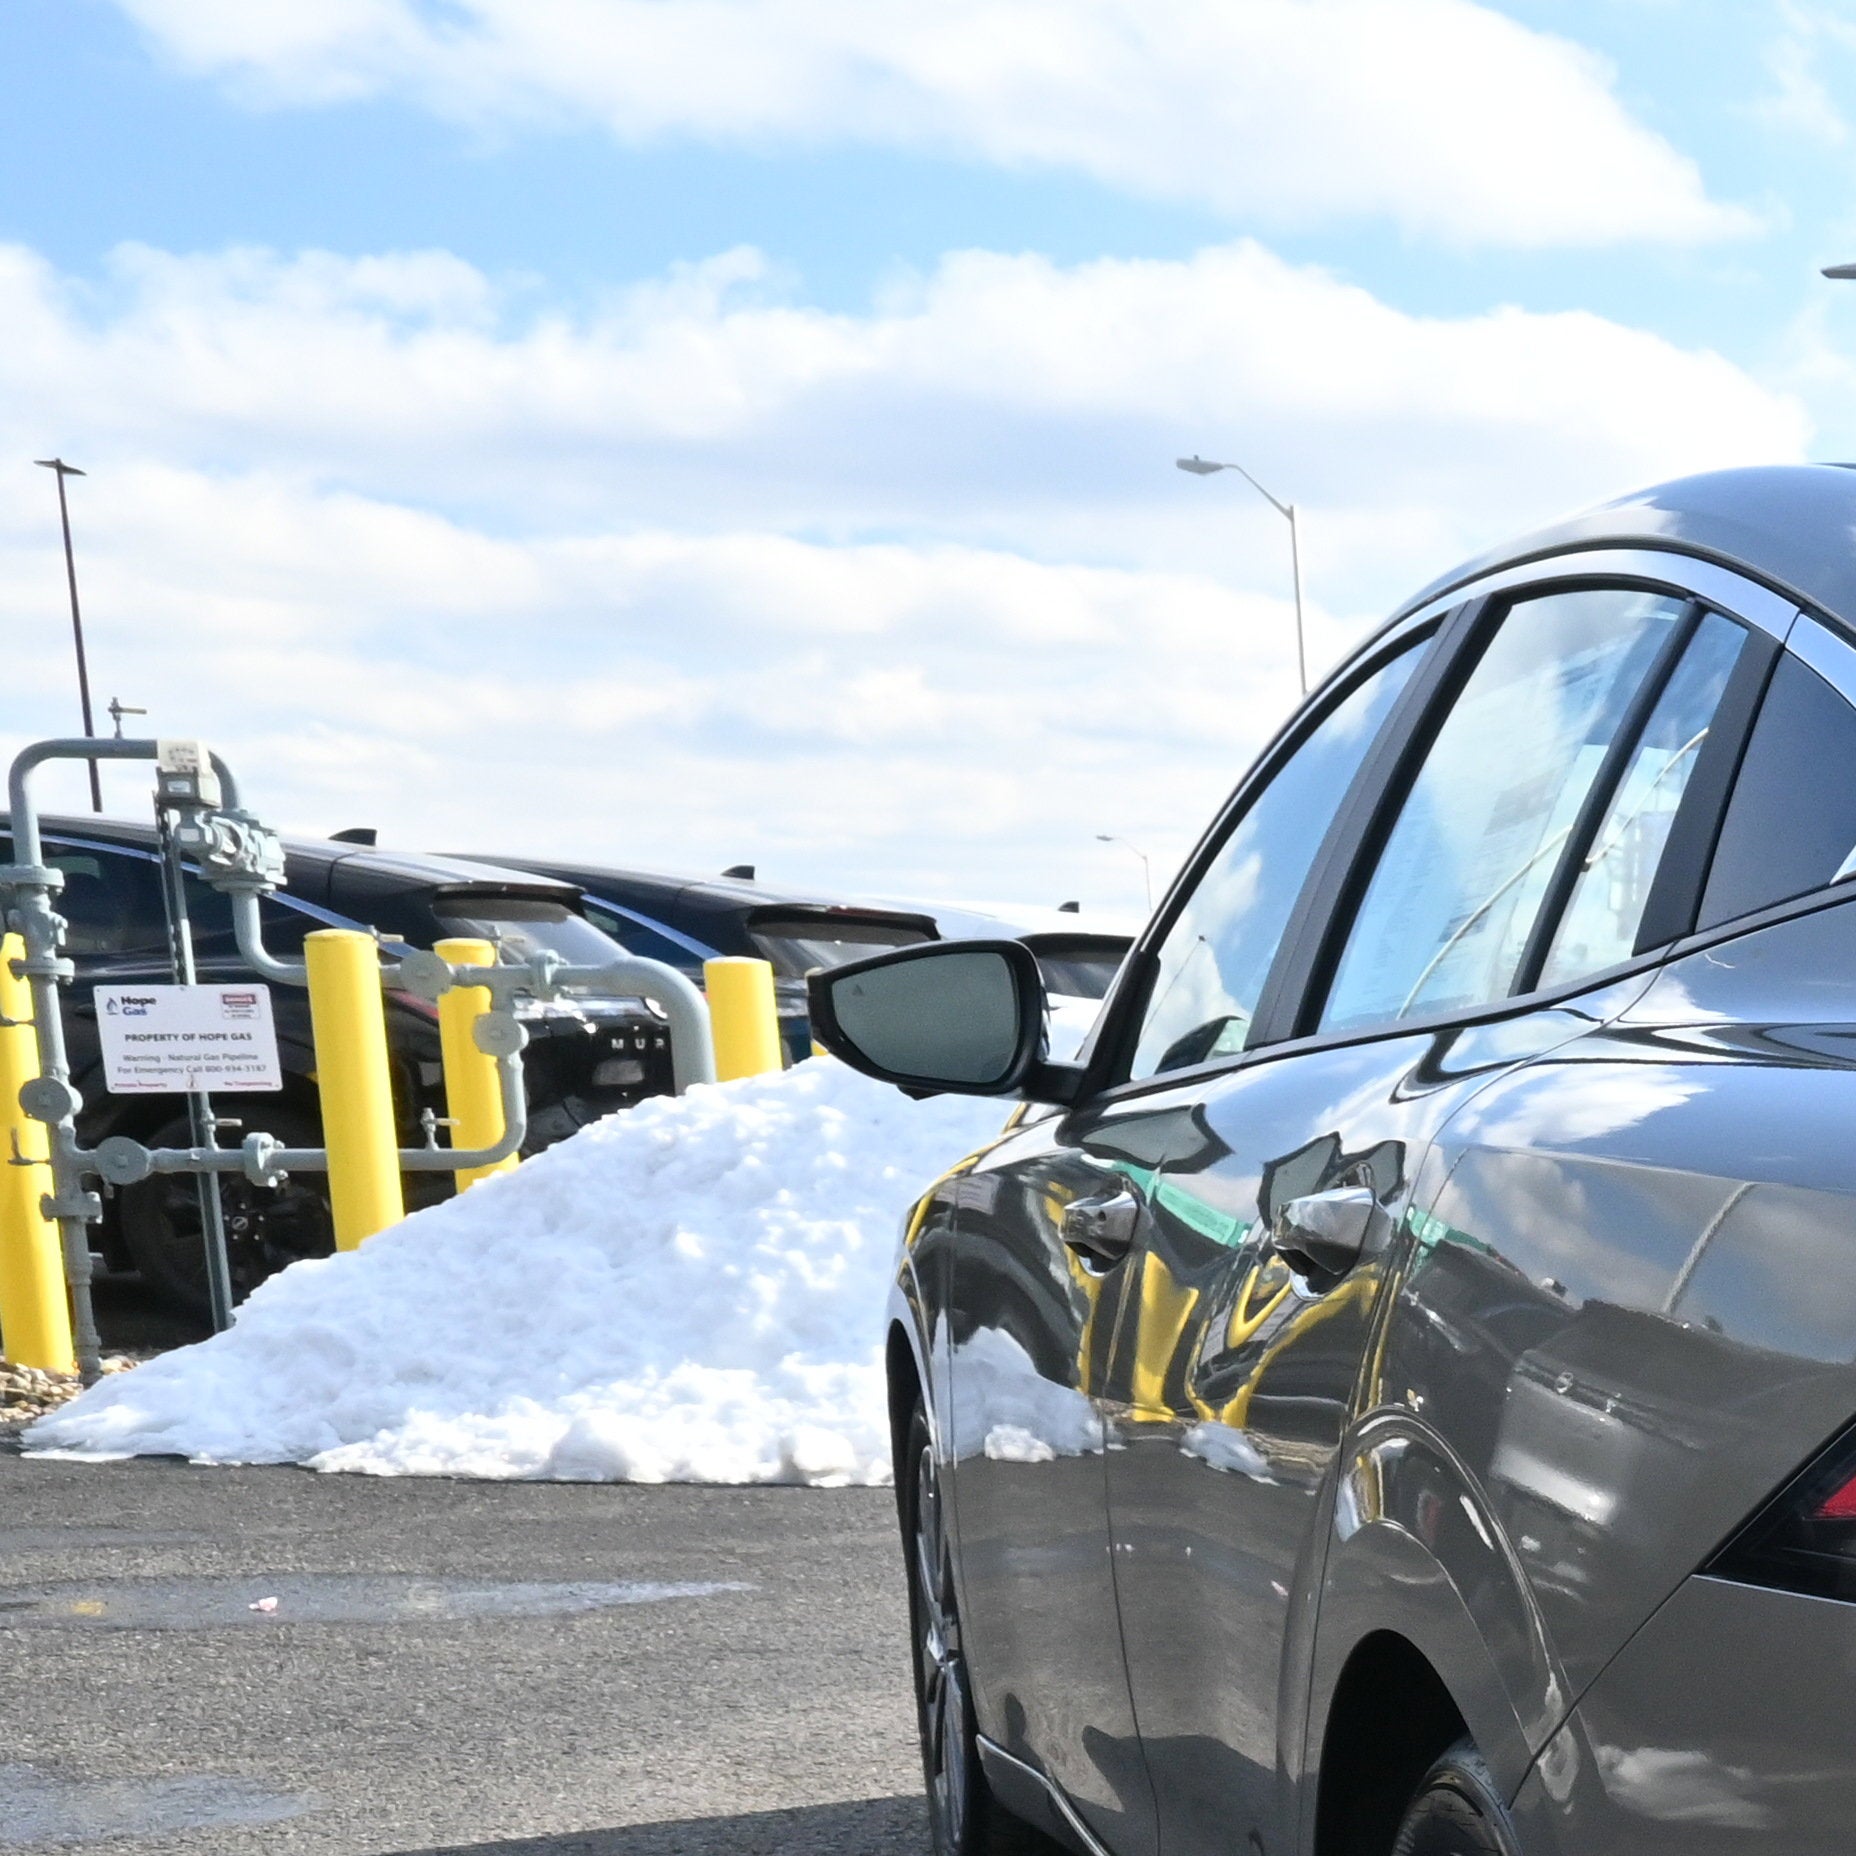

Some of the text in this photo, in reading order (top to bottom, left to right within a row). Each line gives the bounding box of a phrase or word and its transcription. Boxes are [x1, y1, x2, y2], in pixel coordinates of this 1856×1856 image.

[121, 996, 157, 1005] Hope
[122, 1006, 147, 1016] Gas
[125, 1034, 179, 1042] PROPERTY
[182, 1033, 195, 1041] OF
[199, 1033, 228, 1041] HOPE
[611, 1038, 664, 1049] MUR
